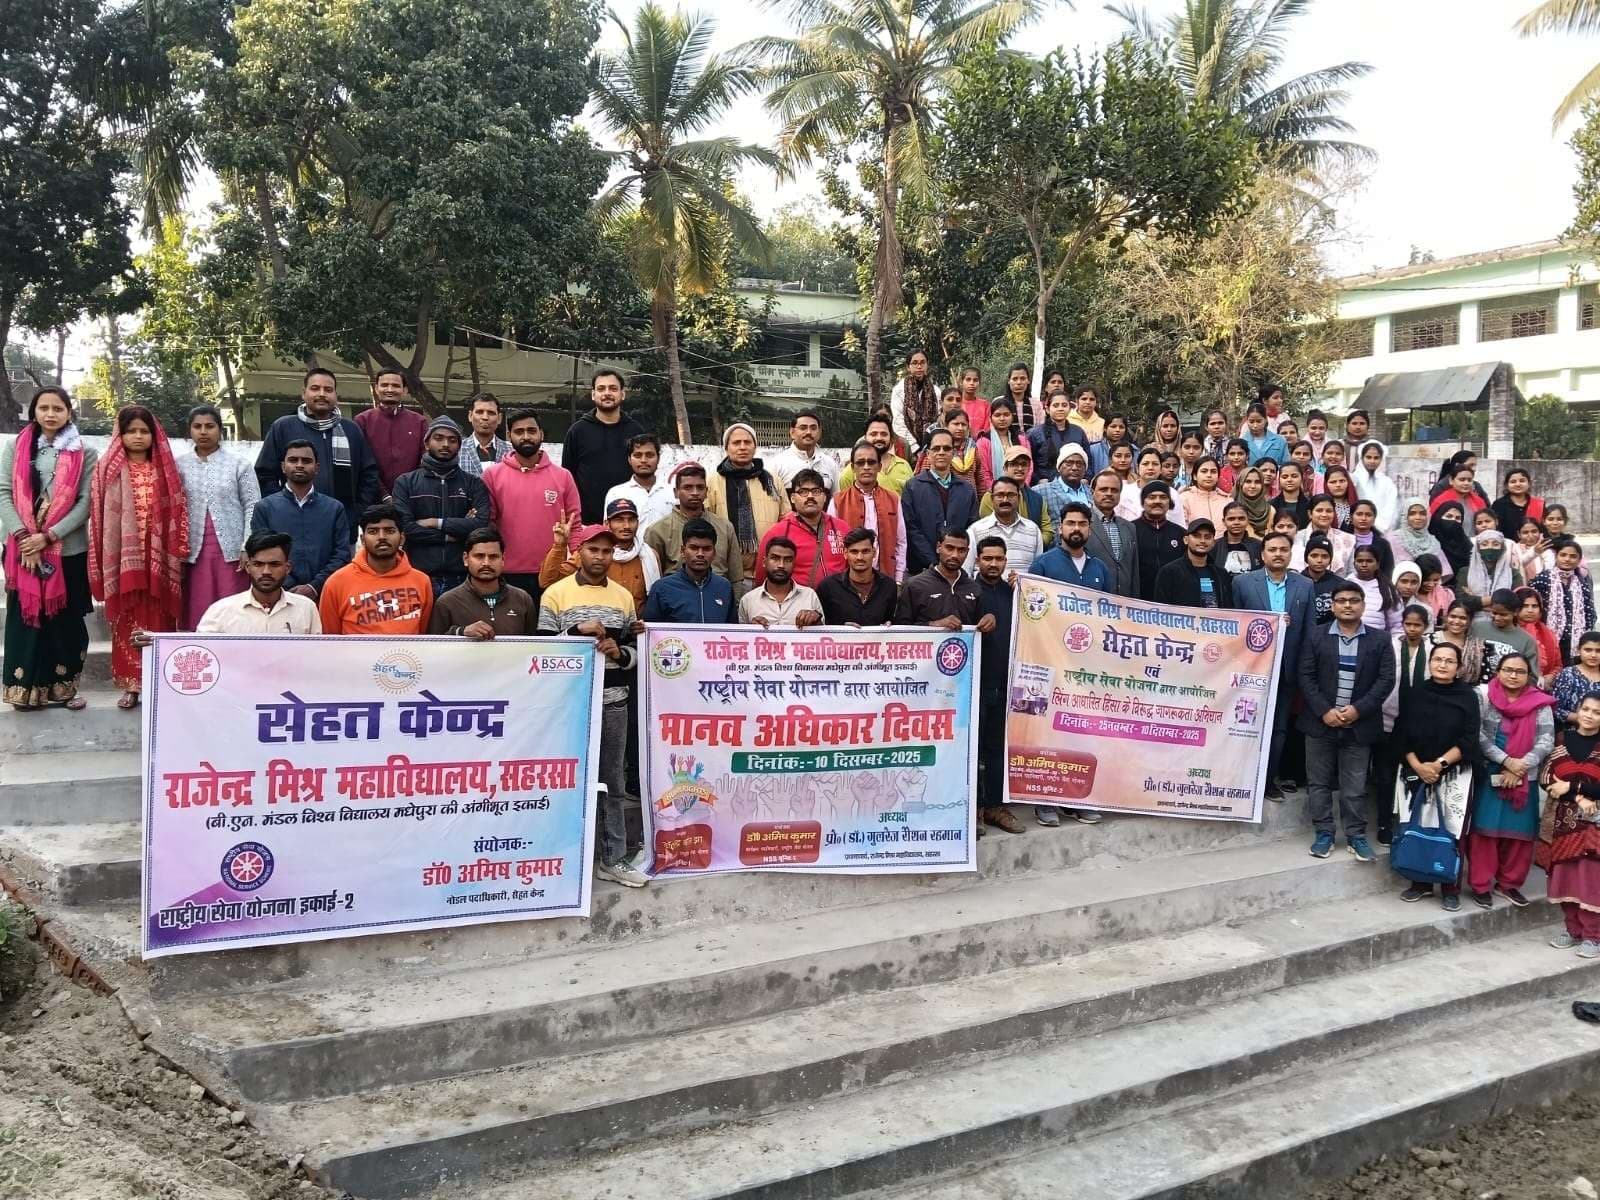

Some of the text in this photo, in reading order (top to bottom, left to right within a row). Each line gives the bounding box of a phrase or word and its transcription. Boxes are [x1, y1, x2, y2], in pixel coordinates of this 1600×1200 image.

[1057, 592, 1093, 615] राजेन्द्र
[1097, 597, 1122, 620] मिश्र
[703, 635, 750, 660] राजेन्द्र
[754, 637, 787, 660] मिश्र
[1102, 625, 1149, 659] सेहत
[1154, 633, 1196, 664] केन्द्र
[542, 656, 583, 670] BSACS
[1144, 664, 1161, 678] एवं
[698, 674, 929, 705] राष्ट्रीय सेवा योजना द्वारा आयोजित
[1063, 668, 1098, 687] राष्ट्रीय
[1100, 670, 1122, 688] सेवा
[1125, 675, 1159, 692] योजना
[1160, 684, 1177, 696] द्वारा
[1179, 685, 1216, 699] आयोजित
[1240, 675, 1267, 687] BSACS
[1052, 686, 1069, 707] लिंग
[1071, 691, 1101, 711] आधारित
[1102, 693, 1121, 713] हिंसा
[1122, 696, 1131, 714] के
[255, 689, 509, 743] सेहत केन्द्र
[659, 702, 956, 746] मानव अधिकार दिवस
[1057, 761, 1090, 774] कुमार
[163, 761, 256, 809] राजेन्द्र
[265, 759, 328, 804] मिश्र
[262, 811, 297, 826] मंडल
[302, 808, 335, 824] विश्व
[339, 806, 390, 821] विद्यालय
[394, 802, 436, 820] मधेपुरा
[440, 800, 458, 815] की
[462, 798, 509, 816] अंगीभूत
[513, 796, 550, 811] इकाई)
[878, 811, 908, 823] अध्यक्ष
[790, 832, 817, 843] कुमार
[867, 827, 899, 846] गुलरेज
[929, 828, 962, 842] रहमान
[458, 858, 512, 883] अमिष
[516, 857, 564, 885] कुमार
[512, 889, 528, 900] सेहत
[530, 888, 545, 898] केन्द्र
[160, 900, 207, 928] राष्ट्रीय
[211, 899, 242, 921] सेवा
[246, 895, 296, 917] योजना
